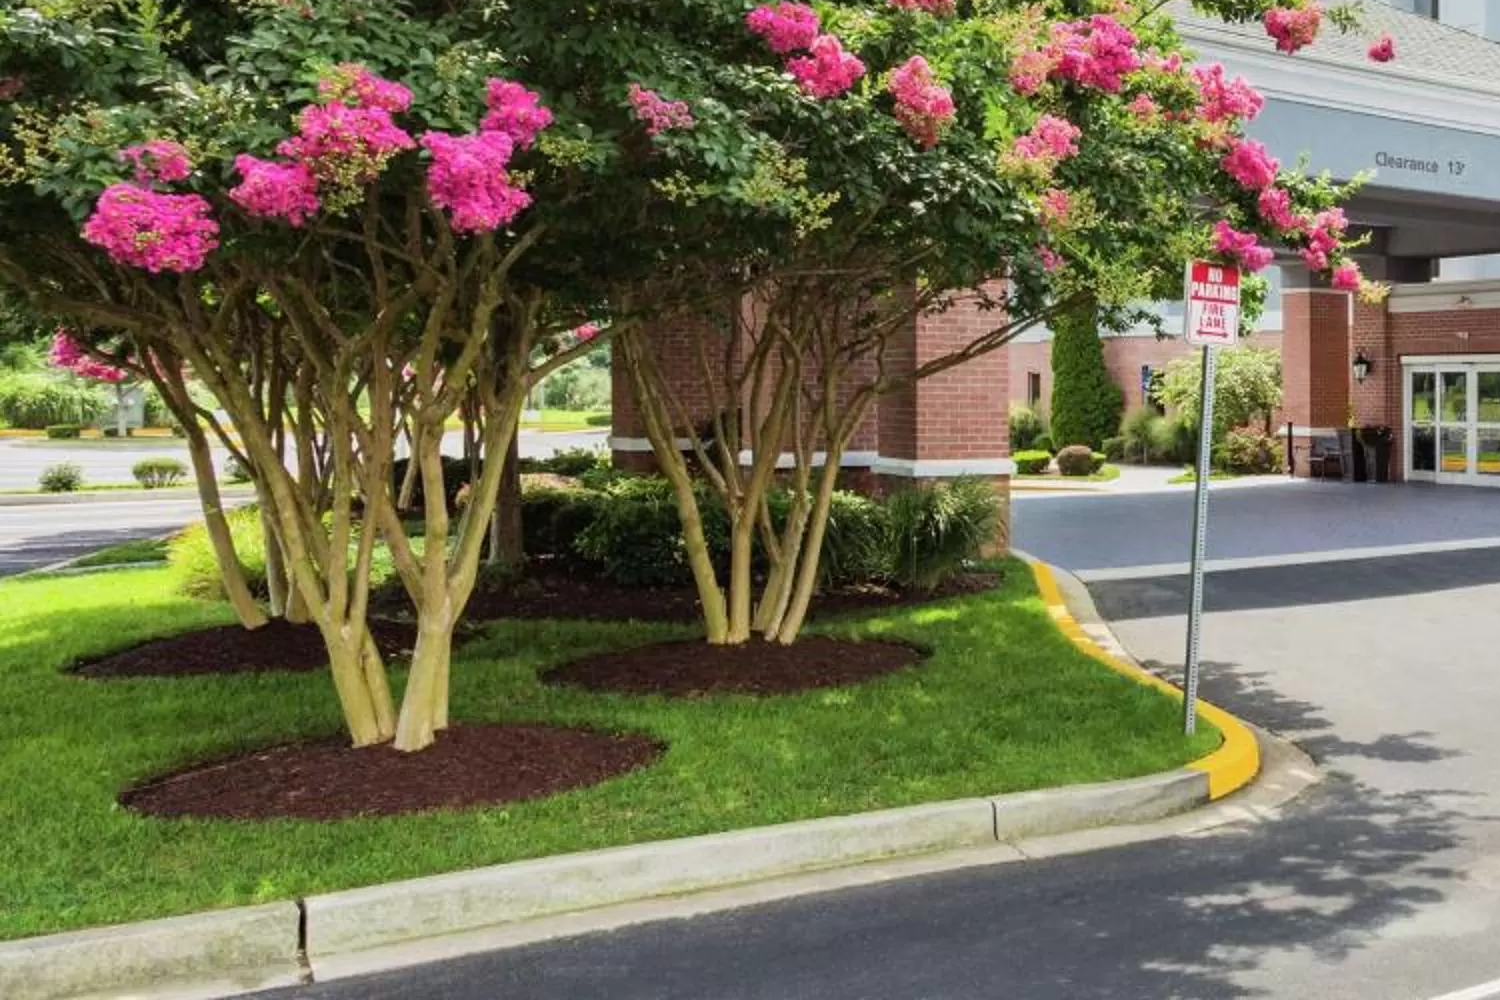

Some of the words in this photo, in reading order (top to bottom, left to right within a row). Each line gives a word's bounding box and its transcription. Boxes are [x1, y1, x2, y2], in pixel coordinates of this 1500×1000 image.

[1375, 151, 1439, 173] Clearance
[1208, 266, 1223, 282] NO
[1191, 281, 1237, 302] PARKING
[1203, 303, 1225, 317] FIRE
[1199, 316, 1225, 329] LANE
